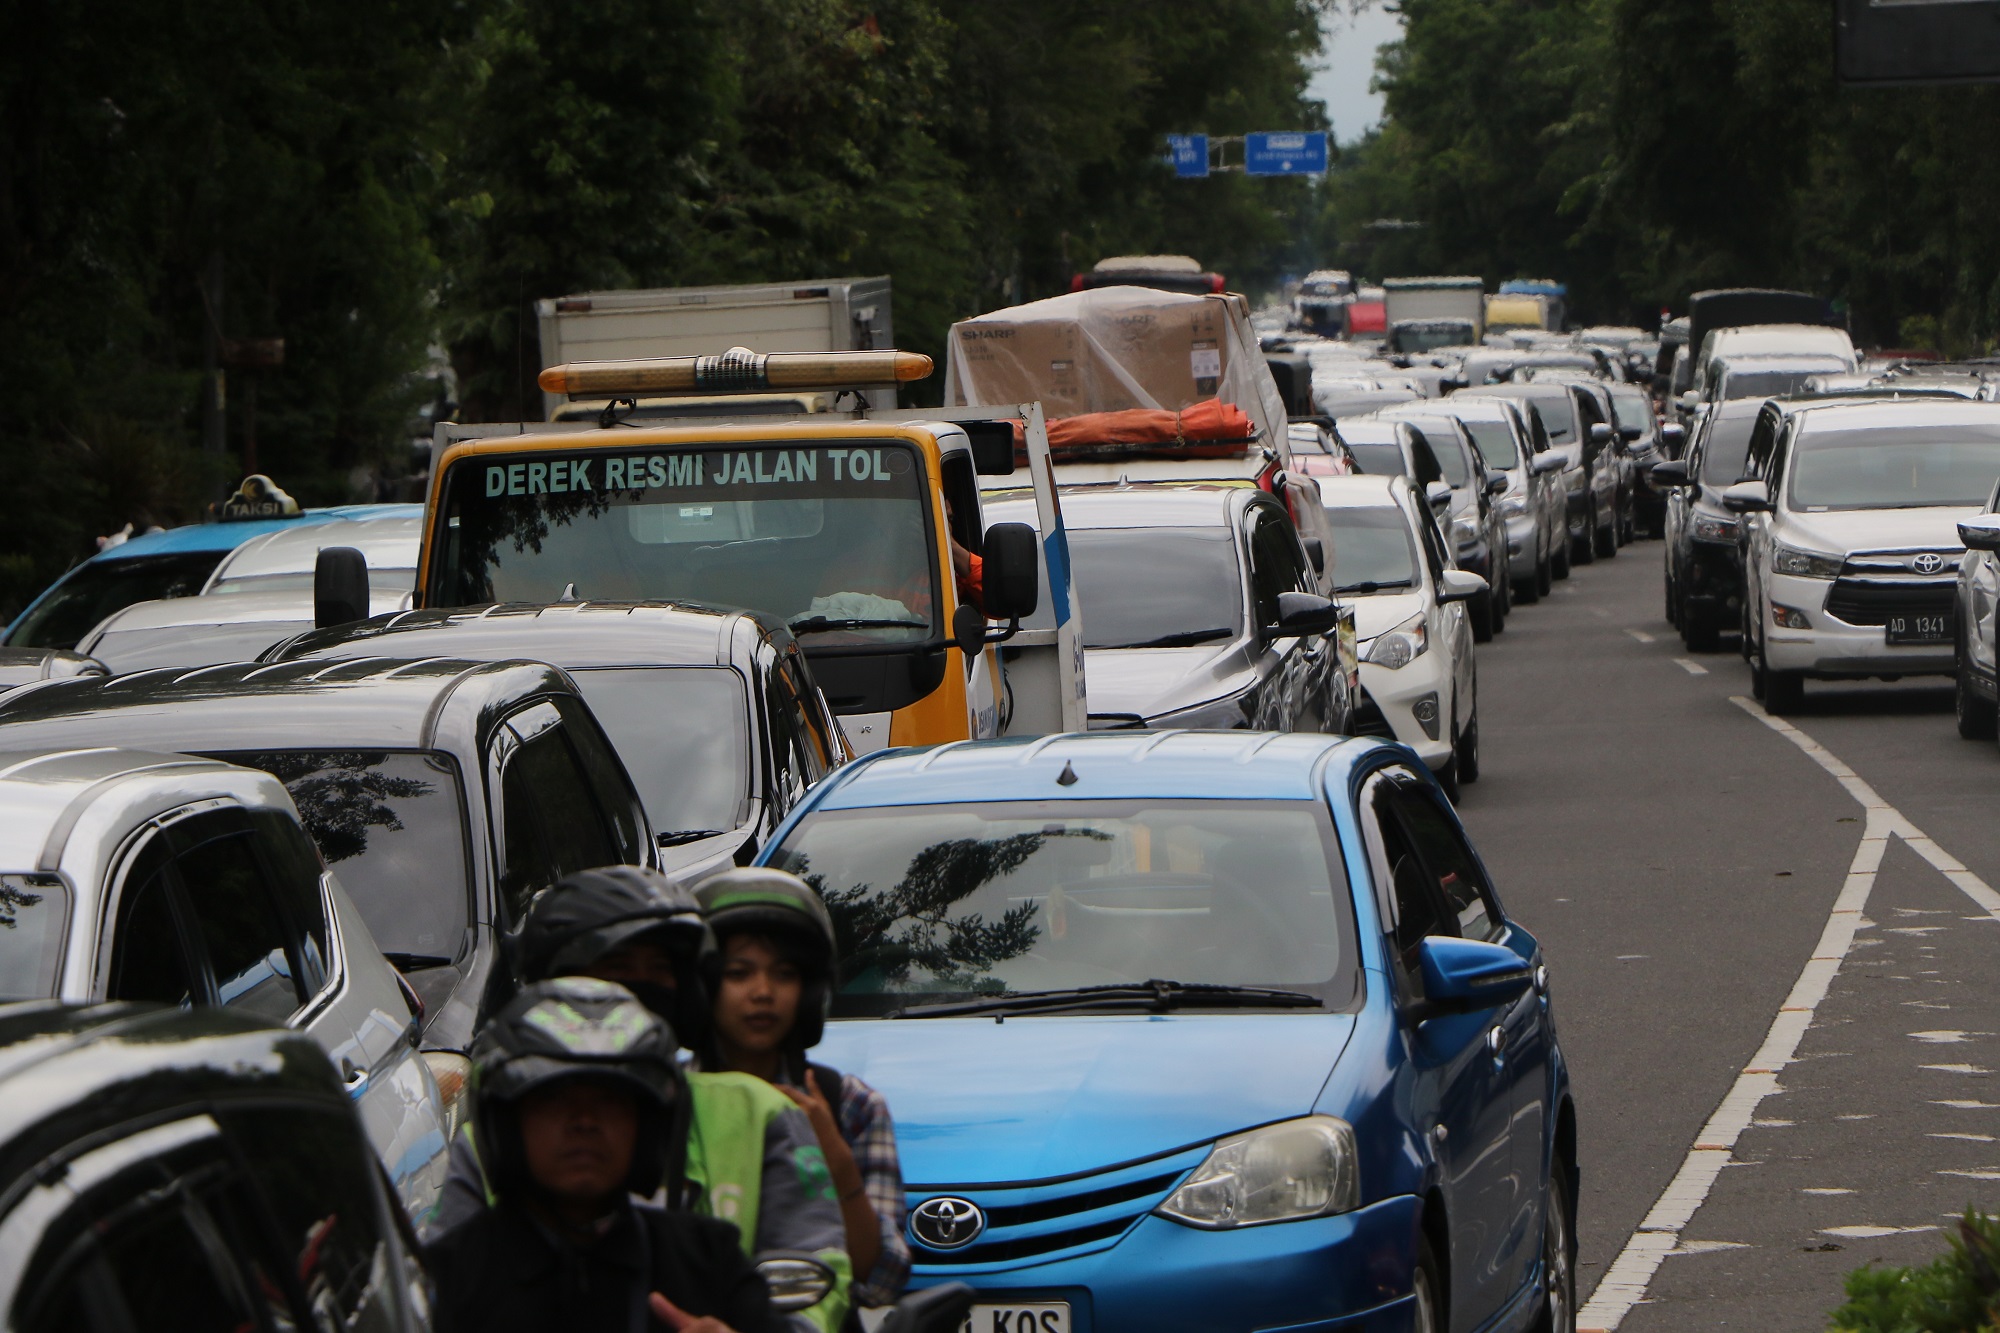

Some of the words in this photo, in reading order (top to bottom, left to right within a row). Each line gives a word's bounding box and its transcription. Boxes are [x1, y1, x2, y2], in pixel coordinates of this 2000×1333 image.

[961, 328, 1016, 340] SHARP
[486, 459, 593, 498] DEREK
[605, 454, 704, 490] RESMI
[713, 451, 817, 485] JALAN
[828, 449, 891, 481] TOL
[231, 502, 279, 516] TAKSI
[1891, 618, 1906, 632] AD
[1915, 617, 1944, 632] 1341
